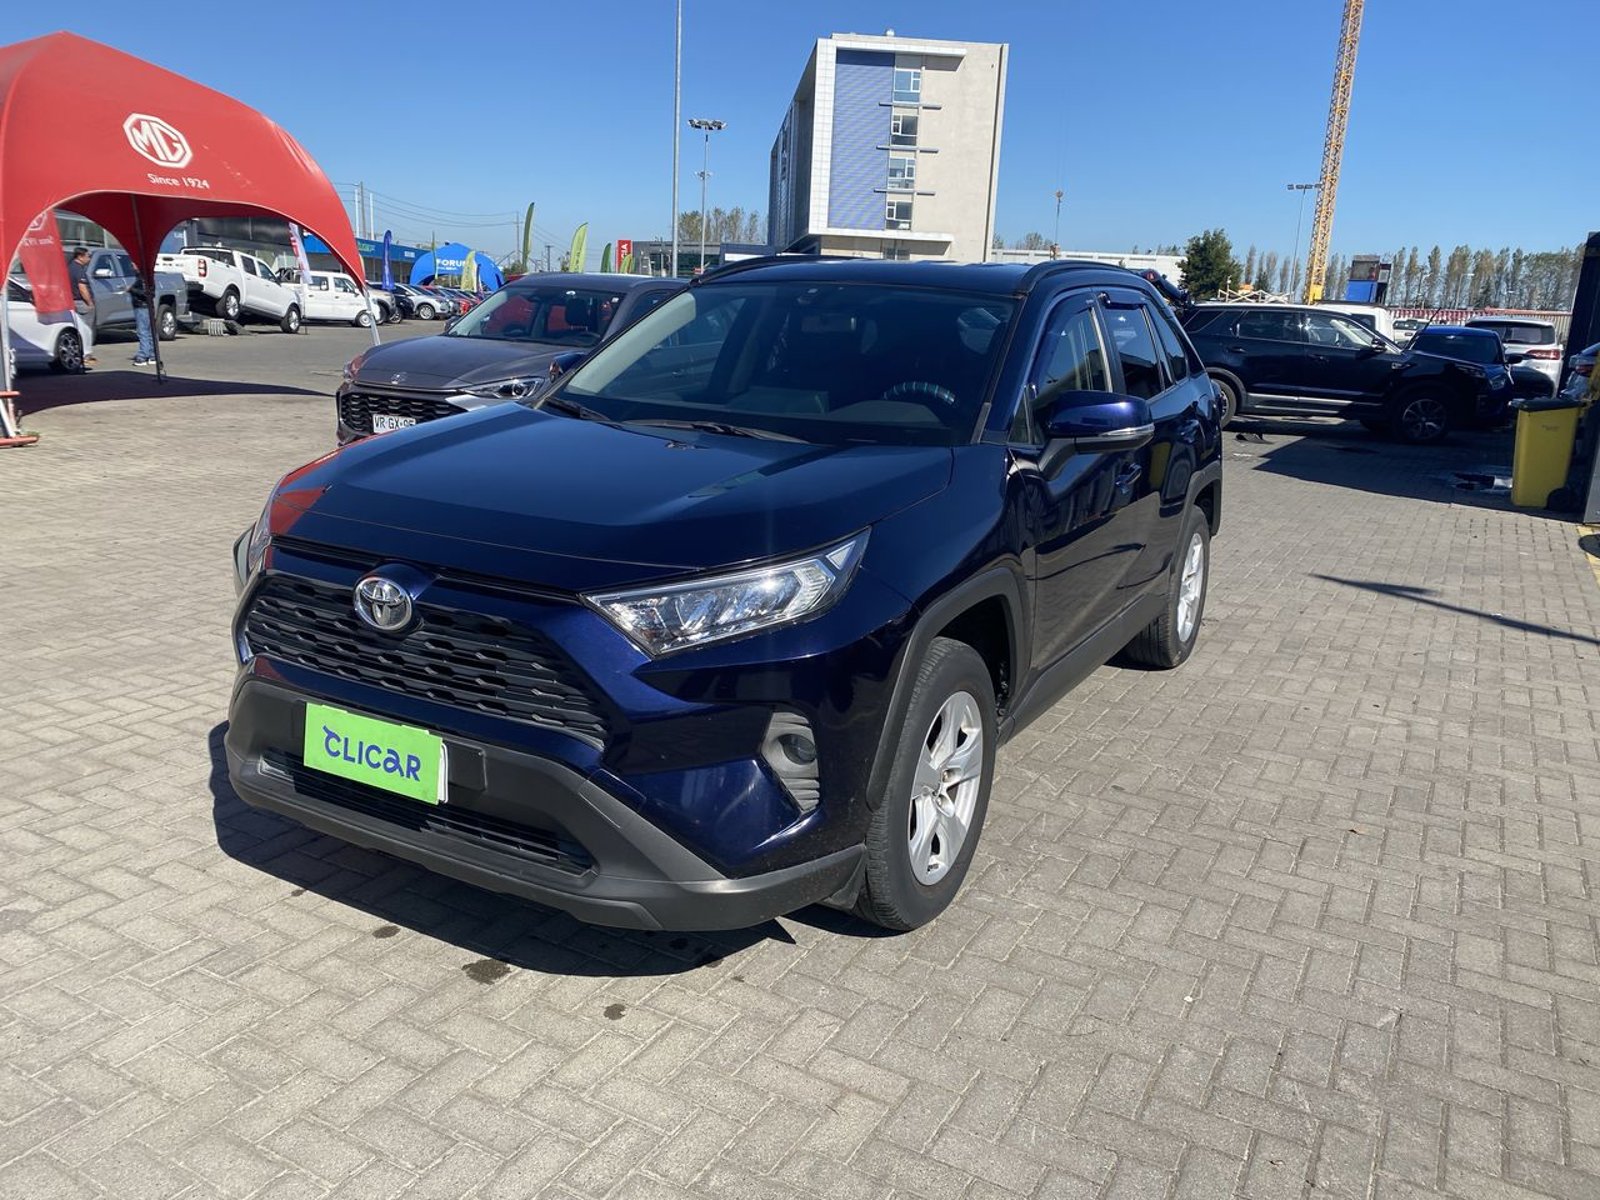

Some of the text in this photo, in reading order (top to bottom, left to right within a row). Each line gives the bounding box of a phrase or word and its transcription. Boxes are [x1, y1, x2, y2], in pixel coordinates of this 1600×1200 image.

[128, 117, 188, 164] MG
[147, 173, 210, 190] Since 1924
